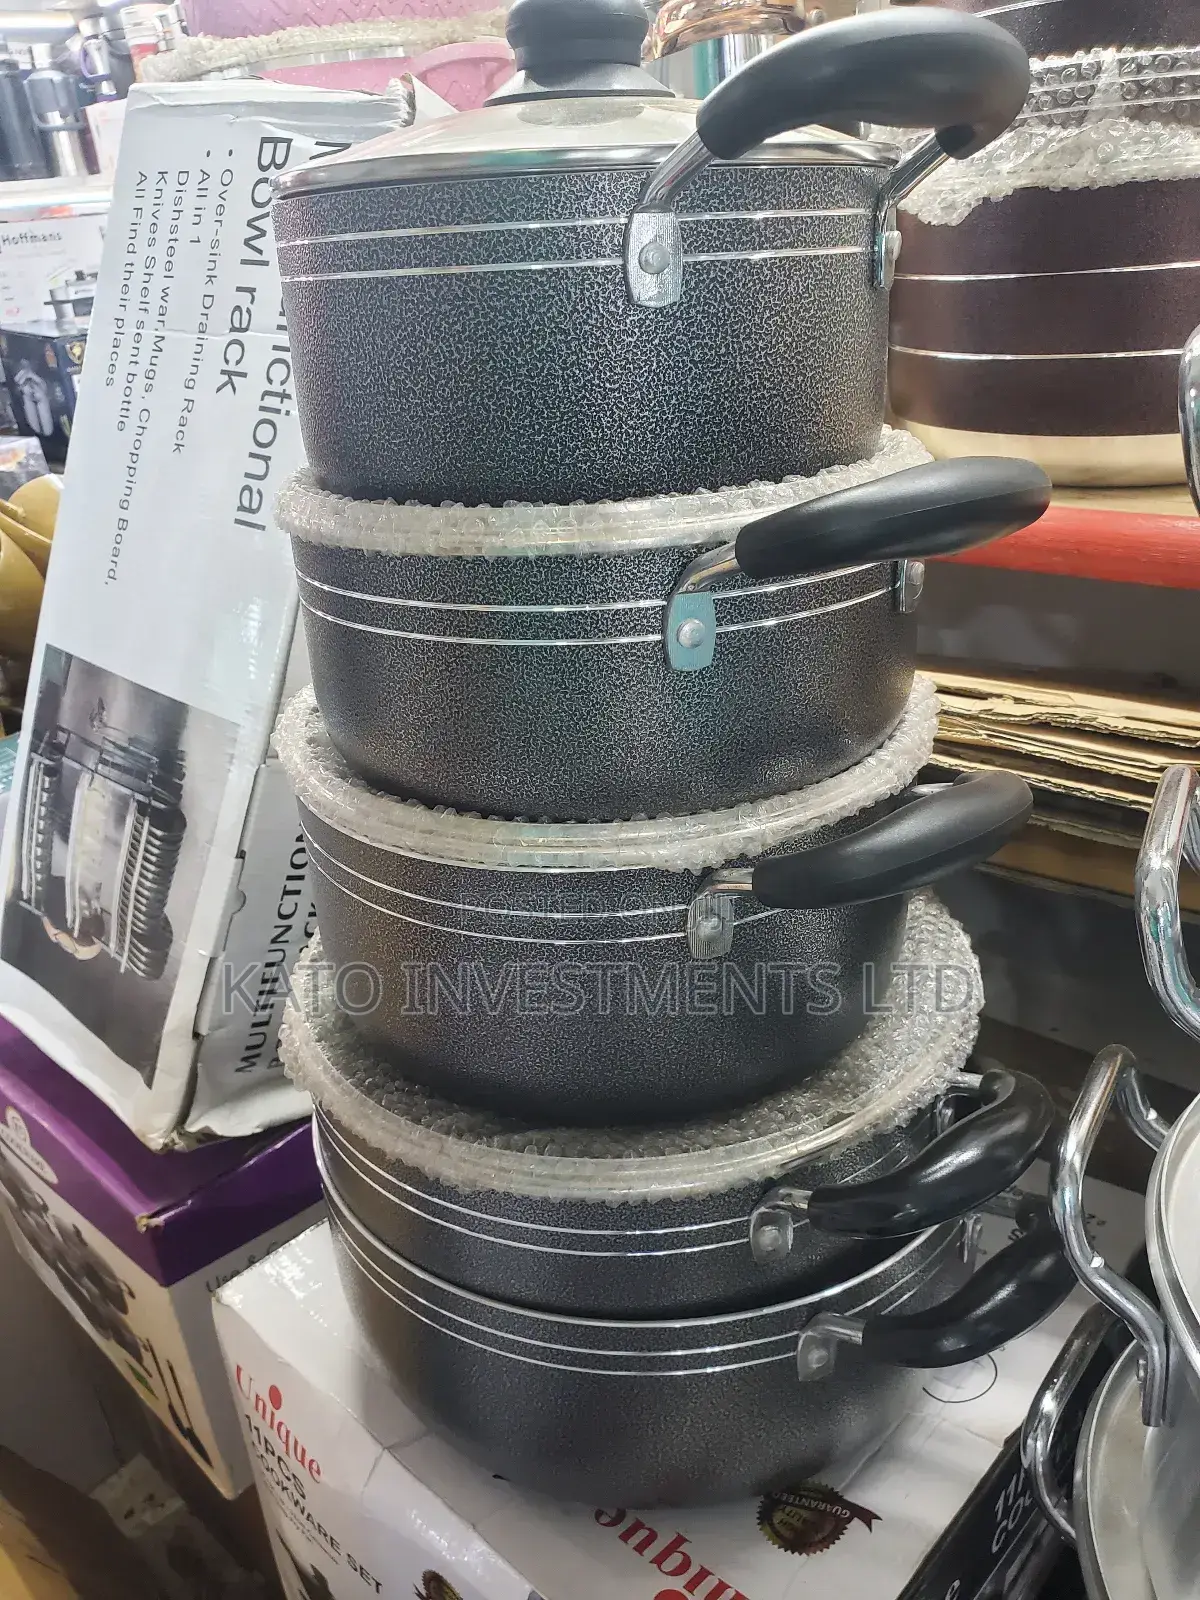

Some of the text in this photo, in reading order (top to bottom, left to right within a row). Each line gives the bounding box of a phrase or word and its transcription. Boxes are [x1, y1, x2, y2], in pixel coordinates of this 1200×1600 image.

[163, 170, 190, 279] Dishsteel
[189, 169, 211, 244] All in 1
[105, 171, 148, 387] All Find their places
[117, 171, 168, 432] Knives Shelf sent bottle
[172, 169, 233, 454] Over-sink Draining Rack
[216, 137, 294, 396] Bowl rack
[119, 408, 151, 511] Chopping
[105, 518, 129, 586] Board,
[234, 832, 309, 1073] MULTIFUNCTIO
[236, 1364, 322, 1484] Unique
[346, 1553, 383, 1595] SET
[594, 1508, 753, 1600] ique
